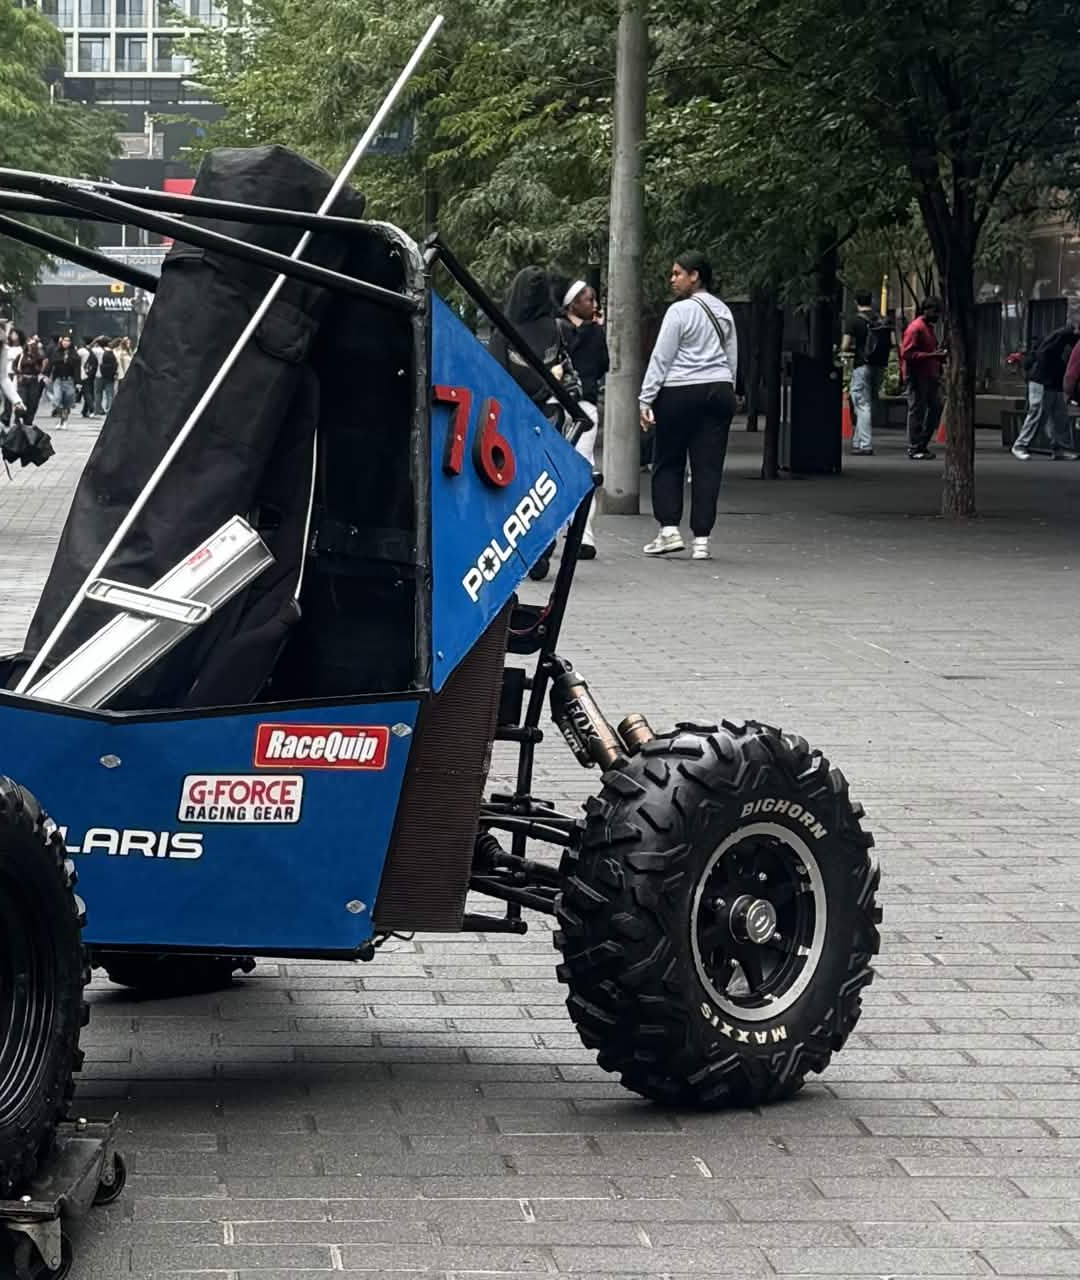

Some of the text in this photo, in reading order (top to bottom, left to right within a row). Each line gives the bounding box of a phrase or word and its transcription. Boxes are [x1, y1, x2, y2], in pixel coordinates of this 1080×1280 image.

[433, 385, 515, 489] 76
[461, 471, 558, 603] POLARIS
[265, 730, 379, 762] RaceQuip
[188, 780, 297, 805] G-FORCE
[185, 806, 294, 820] RACING GEAR
[740, 798, 828, 840] BIGHORN
[58, 826, 204, 859] LARIS
[700, 1001, 788, 1045] MAXXIS
